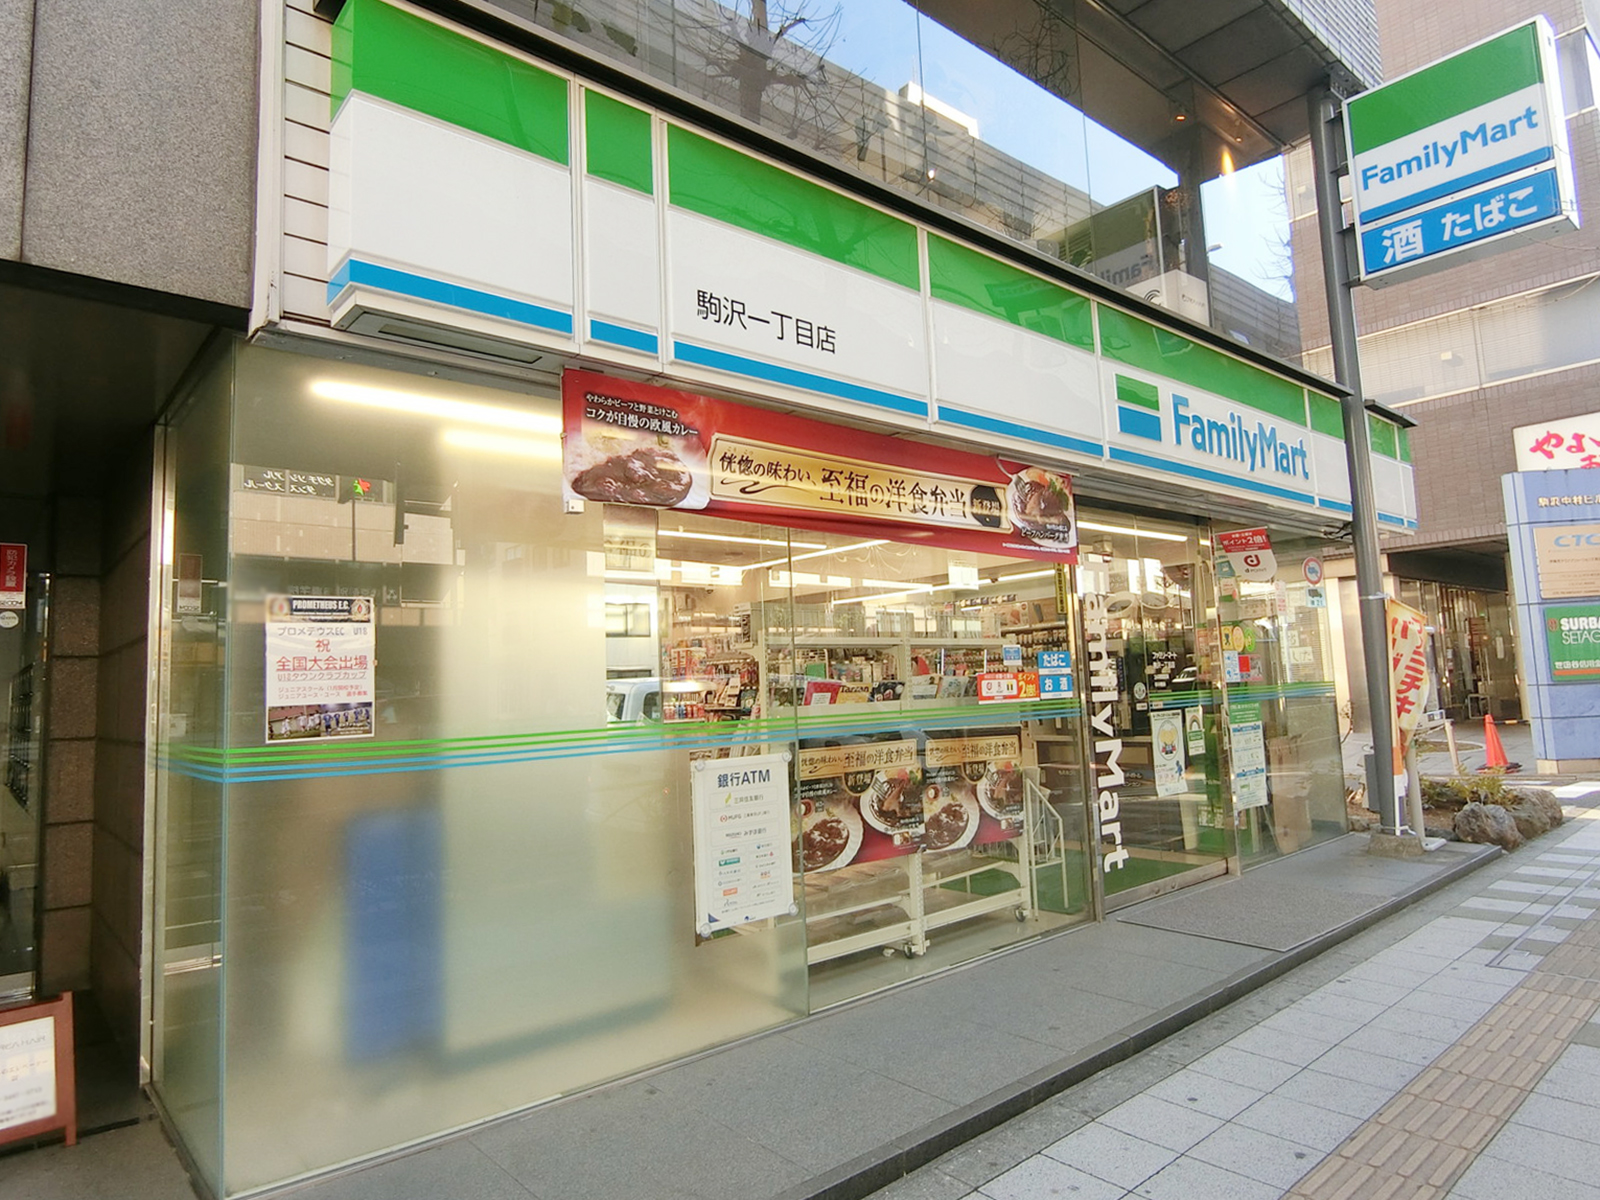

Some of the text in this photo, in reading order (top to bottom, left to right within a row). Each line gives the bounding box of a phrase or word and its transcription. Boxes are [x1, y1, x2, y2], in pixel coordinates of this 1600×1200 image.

[1361, 106, 1539, 190] FamilyMart
[1381, 185, 1538, 264] 酒 たばこ
[697, 289, 836, 354] 駒沢一丁目店
[586, 407, 698, 435] コクが自慢の欧風カレー
[1171, 393, 1309, 480] FamilyMart
[276, 655, 368, 671] 全国大会出場
[315, 639, 331, 653] 祝
[1042, 653, 1066, 667] たばこ
[1083, 560, 1130, 874] FamilyMart
[717, 769, 771, 788] 銀行ATM
